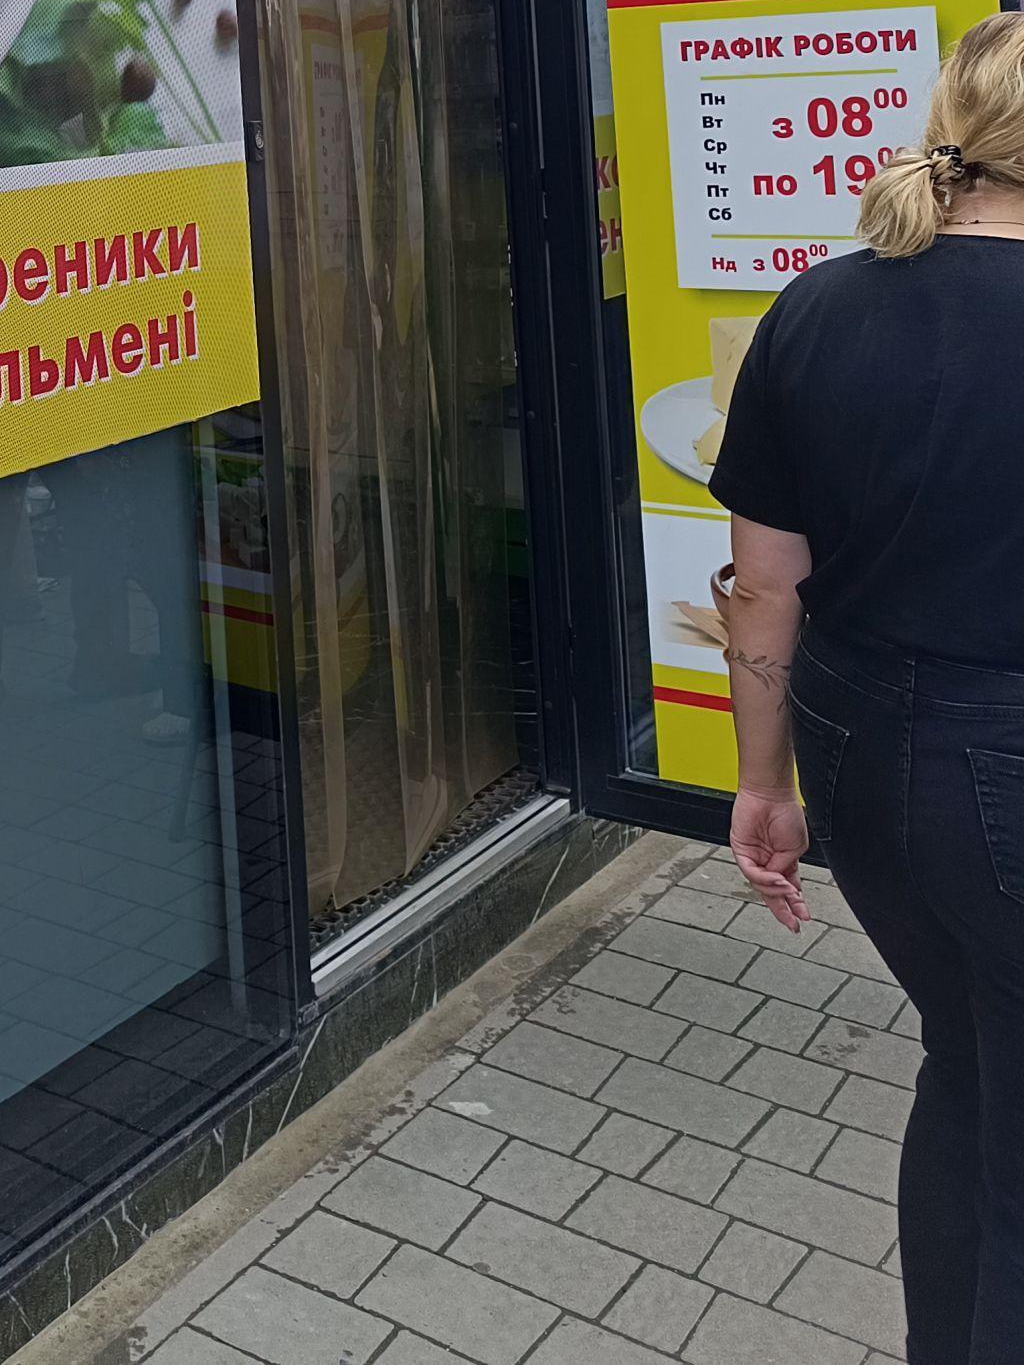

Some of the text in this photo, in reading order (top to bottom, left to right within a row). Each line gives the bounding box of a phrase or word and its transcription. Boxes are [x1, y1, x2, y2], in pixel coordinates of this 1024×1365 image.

[679, 29, 917, 62] ГРАФІК РОБОТИ
[700, 92, 726, 106] Пн
[702, 115, 723, 128] Вт
[703, 138, 728, 154] Ср
[705, 161, 727, 174] Чт
[706, 184, 729, 197] Пт
[753, 174, 798, 196] по
[708, 207, 733, 221] Сб
[711, 256, 738, 272] Нд
